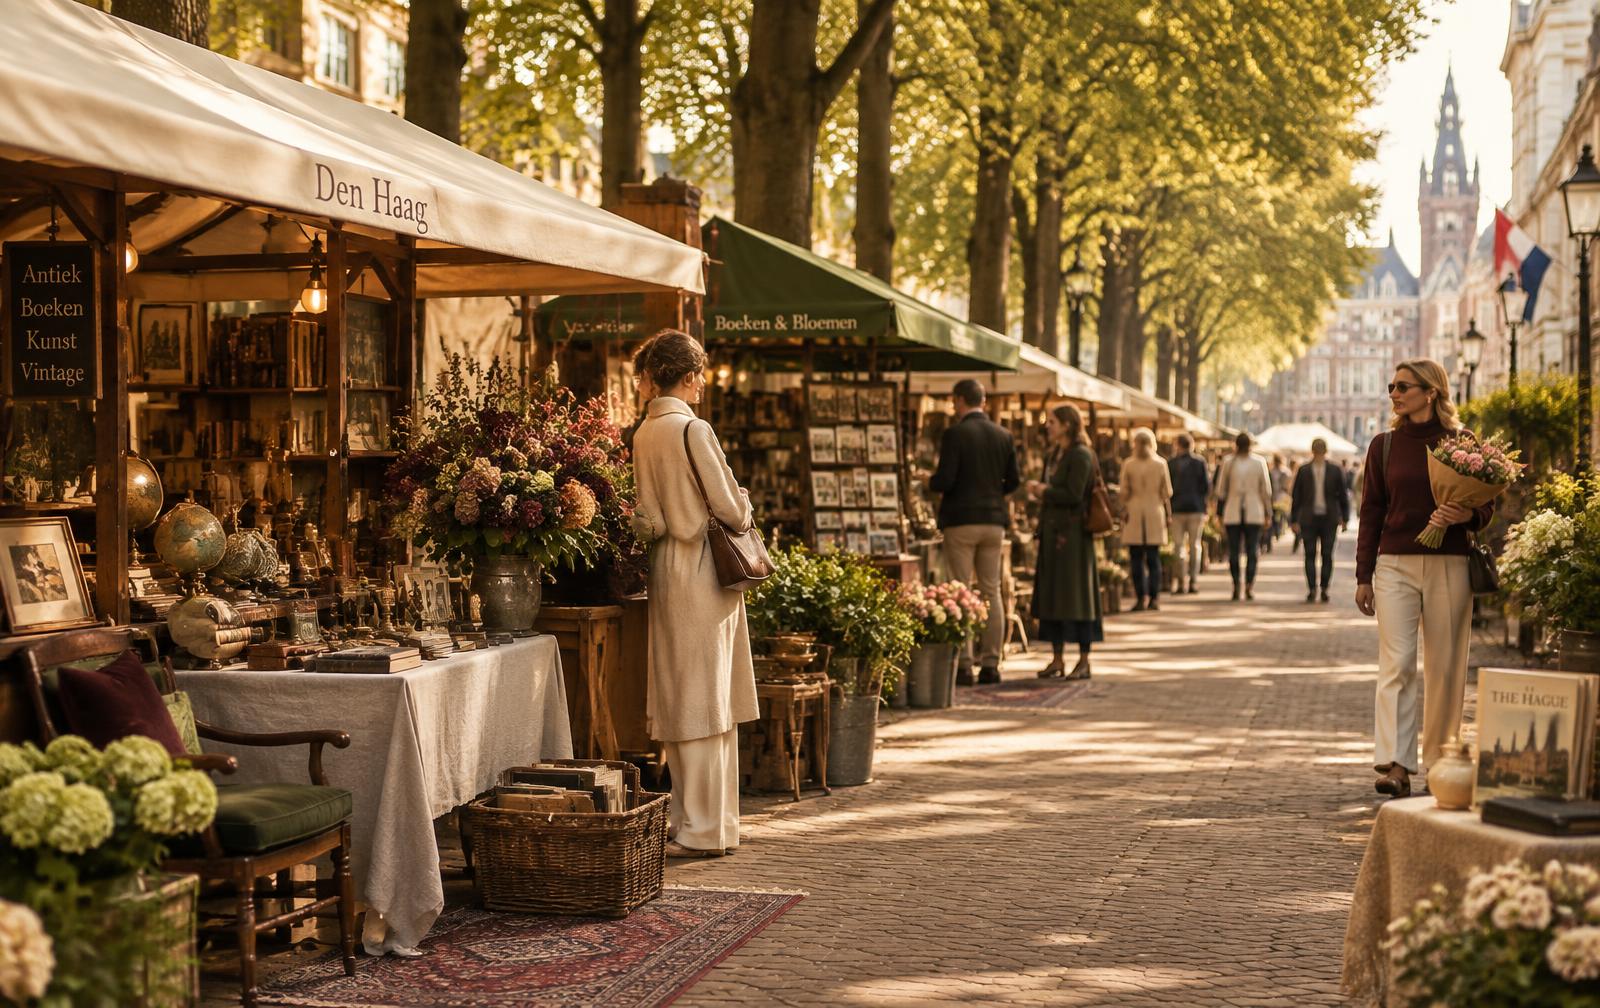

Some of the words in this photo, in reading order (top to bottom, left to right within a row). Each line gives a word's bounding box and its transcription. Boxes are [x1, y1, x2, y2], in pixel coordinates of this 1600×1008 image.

[315, 163, 364, 210] Den
[372, 177, 429, 235] Haag
[22, 264, 82, 284] Antiek
[20, 297, 84, 317] Boeken
[715, 315, 770, 331] Boeken
[775, 315, 789, 331] &
[792, 314, 858, 331] Bloemen
[26, 329, 78, 350] Kunst
[20, 362, 85, 387] Vintage
[1491, 690, 1519, 704] THE
[1522, 692, 1569, 709] HAGUE
